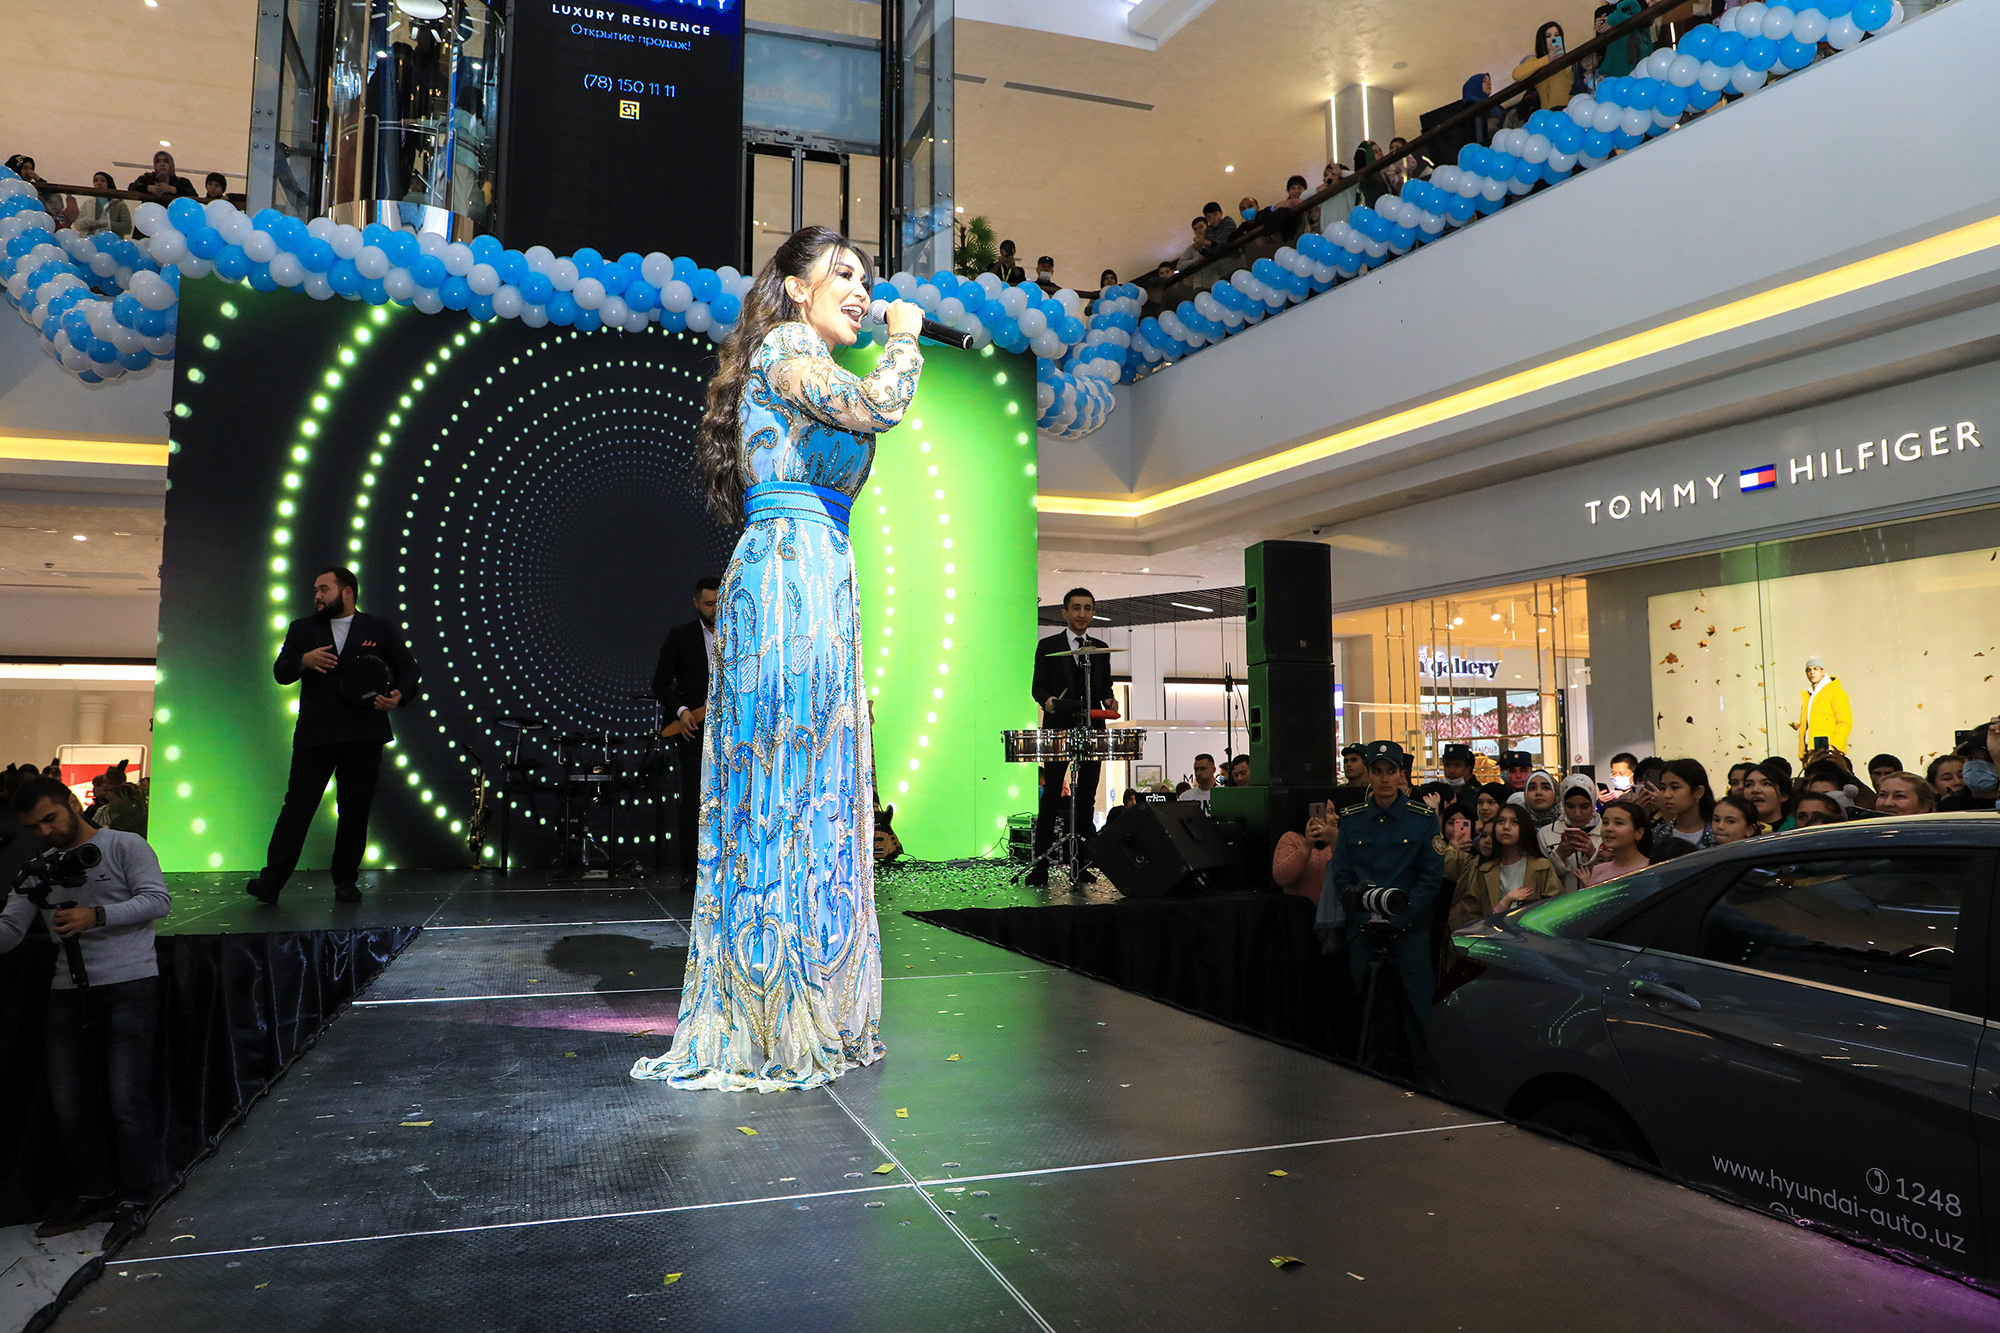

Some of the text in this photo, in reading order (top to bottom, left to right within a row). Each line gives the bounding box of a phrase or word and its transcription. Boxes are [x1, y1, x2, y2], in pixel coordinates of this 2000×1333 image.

[552, 3, 711, 36] LUXURY RESIDENCE
[571, 23, 691, 50] Открытие продаж!
[584, 73, 676, 97] (78) 150 11 11
[1584, 421, 1982, 525] TOMMY HILFIGER
[1431, 657, 1499, 679] gallery
[1712, 1155, 1967, 1254] www.hyundai-auto.uz
[1896, 1178, 1963, 1218] 1248
